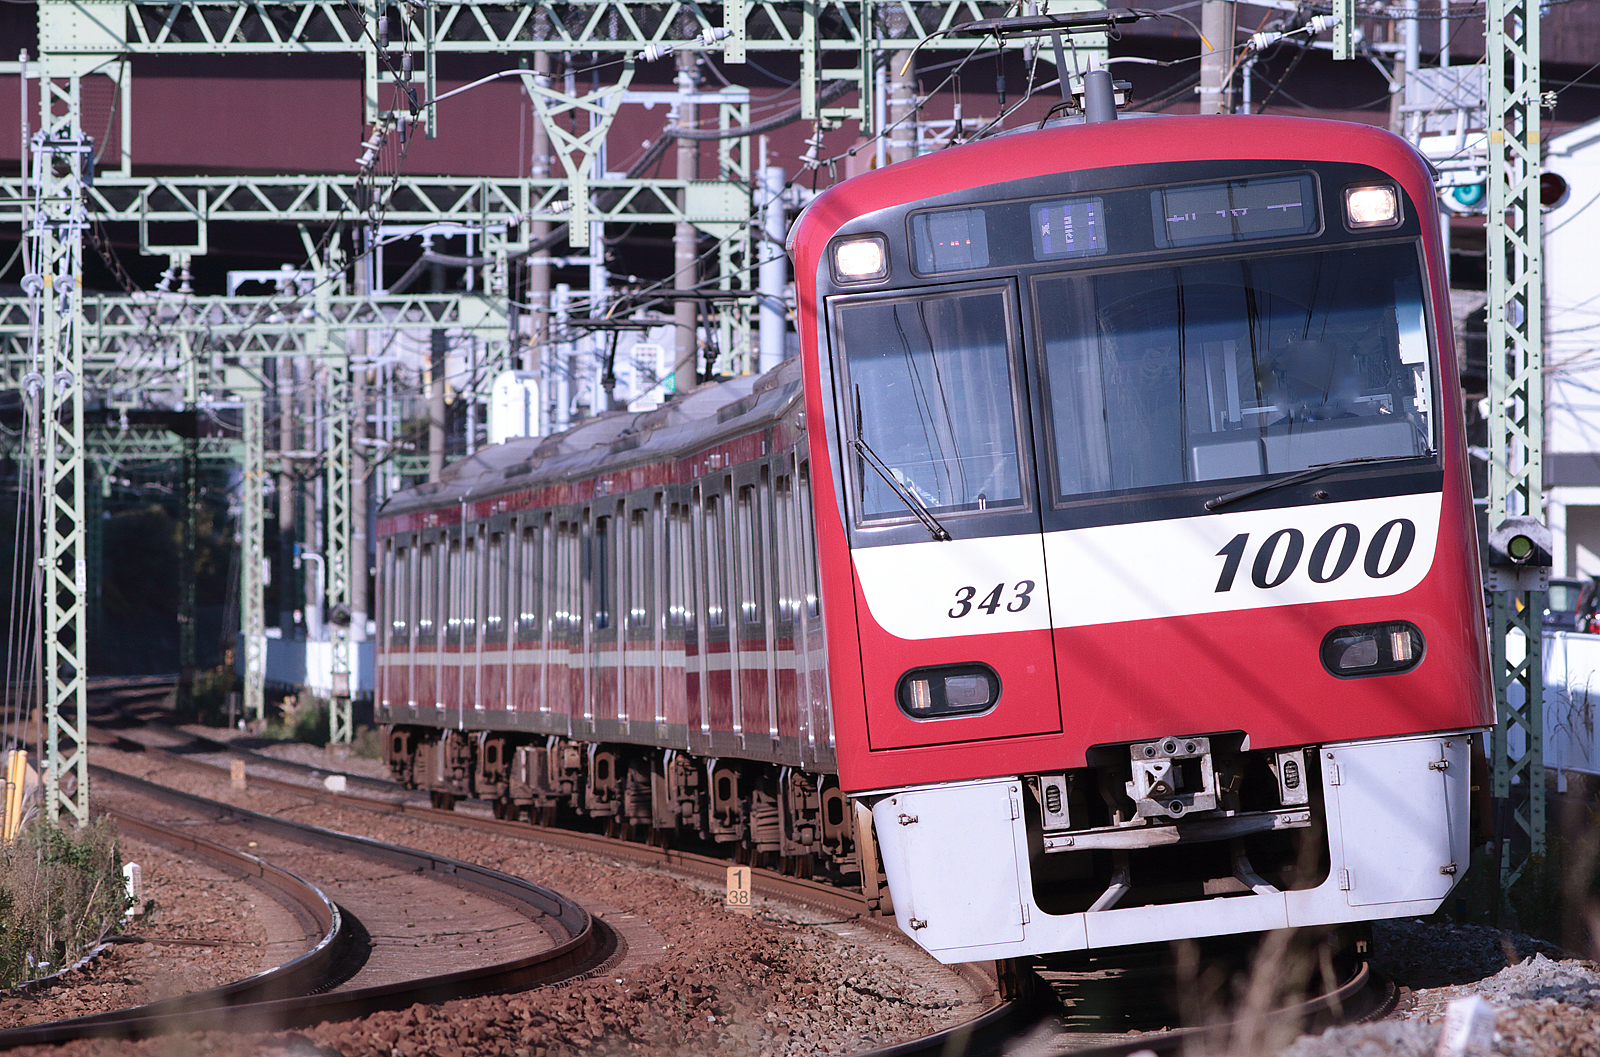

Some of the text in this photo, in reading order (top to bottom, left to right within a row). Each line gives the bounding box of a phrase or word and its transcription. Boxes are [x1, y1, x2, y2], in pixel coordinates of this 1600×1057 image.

[1214, 518, 1416, 593] 1000
[948, 580, 1036, 619] 343
[733, 869, 742, 890] 1
[729, 890, 748, 904] 38
